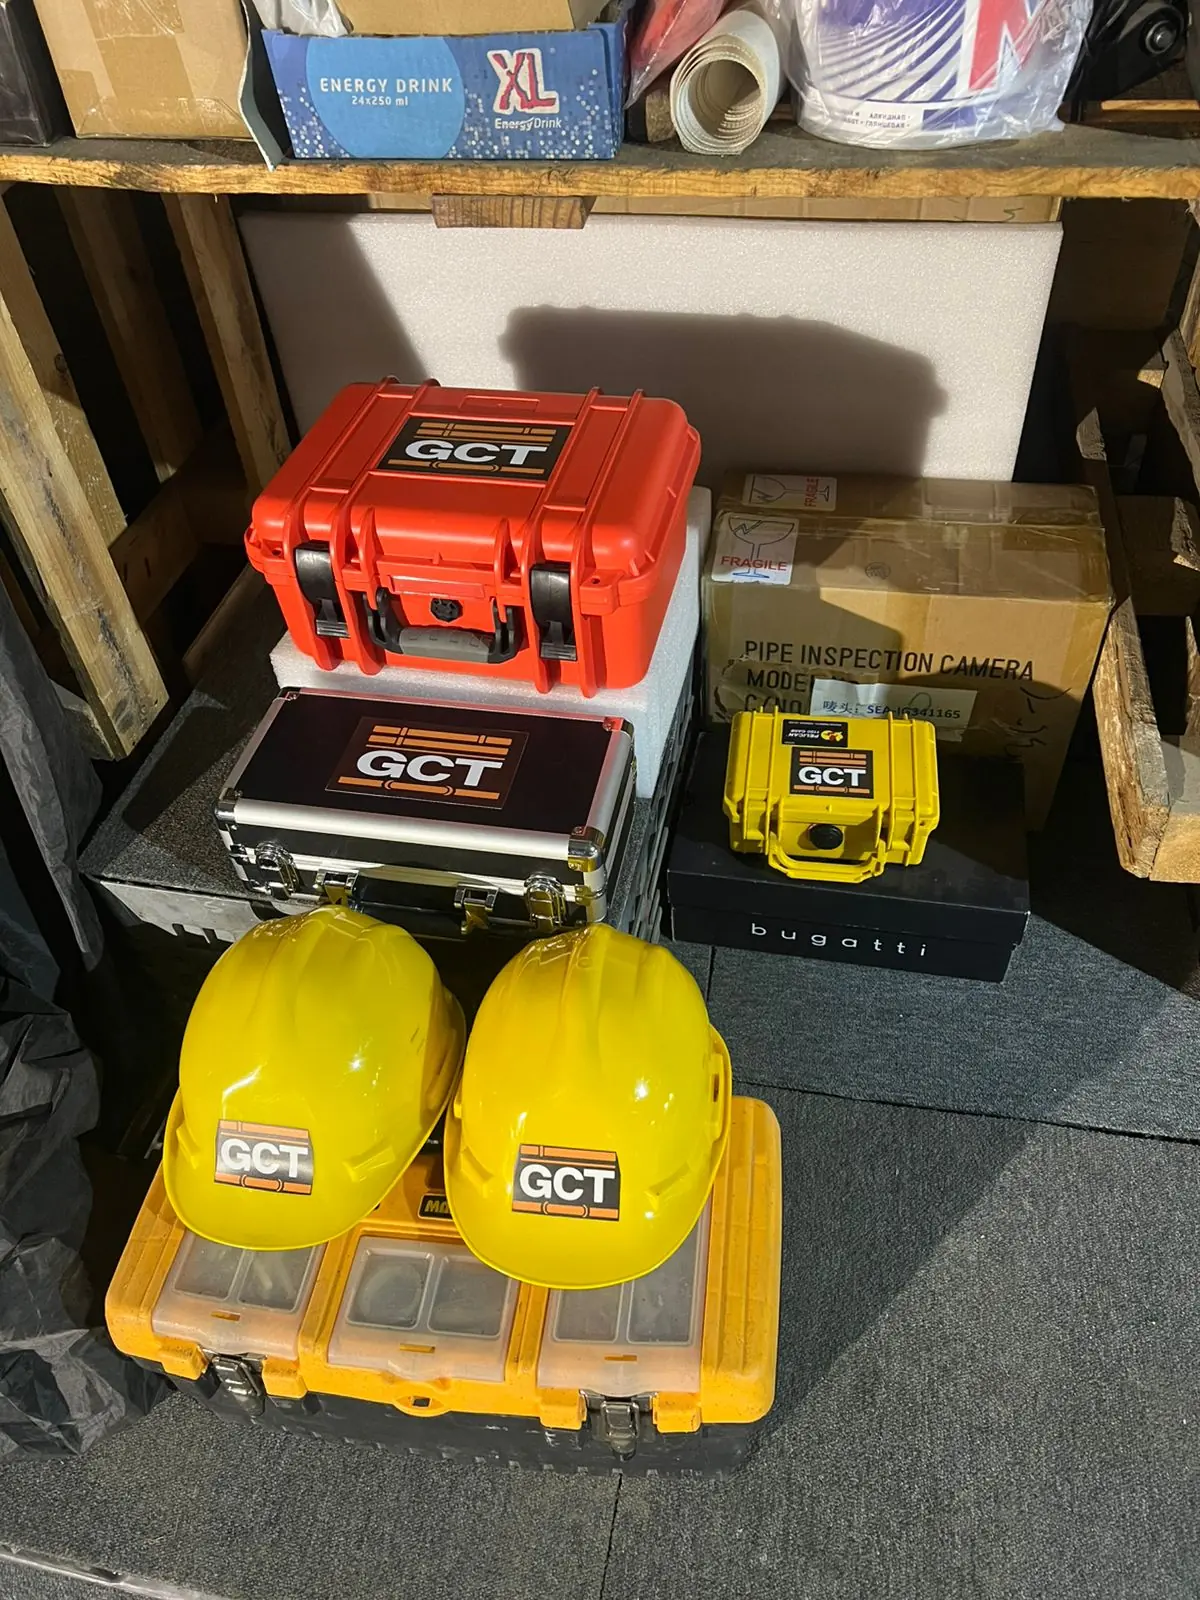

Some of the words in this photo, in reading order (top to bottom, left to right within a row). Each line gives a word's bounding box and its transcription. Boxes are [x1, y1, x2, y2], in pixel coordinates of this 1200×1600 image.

[320, 78, 388, 93] ENERGY
[396, 78, 453, 93] DRINK
[488, 49, 560, 114] XL
[351, 96, 392, 106] 24x250
[395, 97, 409, 107] ml
[405, 440, 547, 465] GCT
[721, 556, 788, 571] FRAGILE
[745, 641, 793, 663] PIPE
[800, 645, 933, 673] INSPECTION
[939, 655, 1034, 682] CAMERA
[356, 750, 503, 787] GCT
[798, 766, 866, 787] GCT
[751, 922, 927, 957] bugatti
[220, 1138, 308, 1178] GCT
[519, 1163, 615, 1203] GCT
